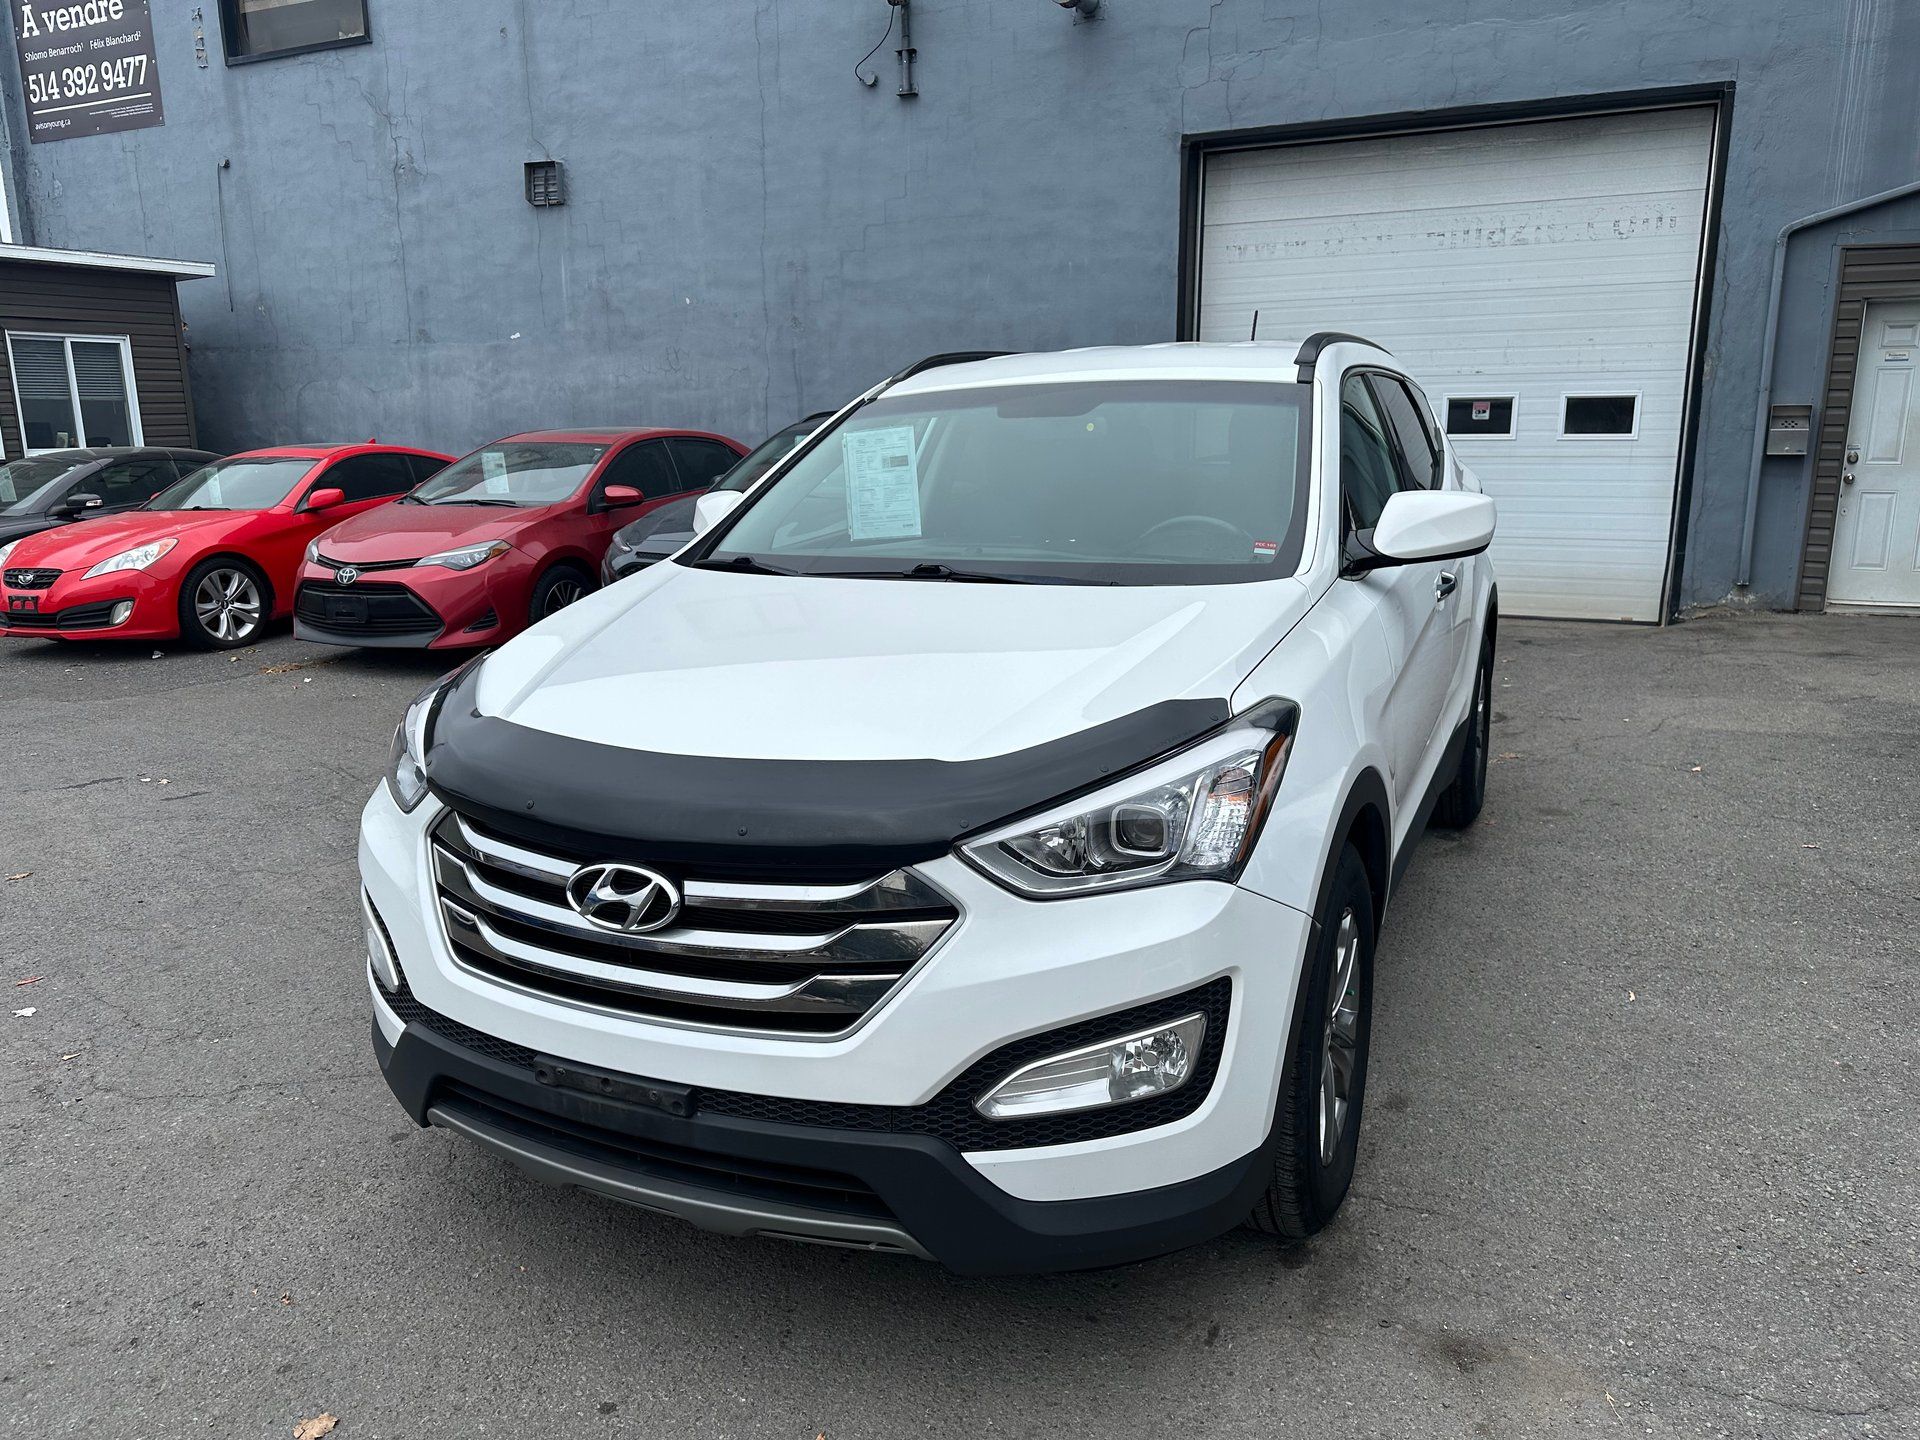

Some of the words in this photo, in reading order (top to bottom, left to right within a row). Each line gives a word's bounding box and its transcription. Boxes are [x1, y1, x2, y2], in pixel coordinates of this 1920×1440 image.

[42, 0, 124, 33] vendre
[25, 50, 47, 62] Shlomo
[89, 37, 105, 50] Félix
[28, 70, 61, 104] 514
[62, 63, 99, 98] 392
[100, 54, 148, 91] 9477
[35, 118, 71, 130] avisonyoung.ca
